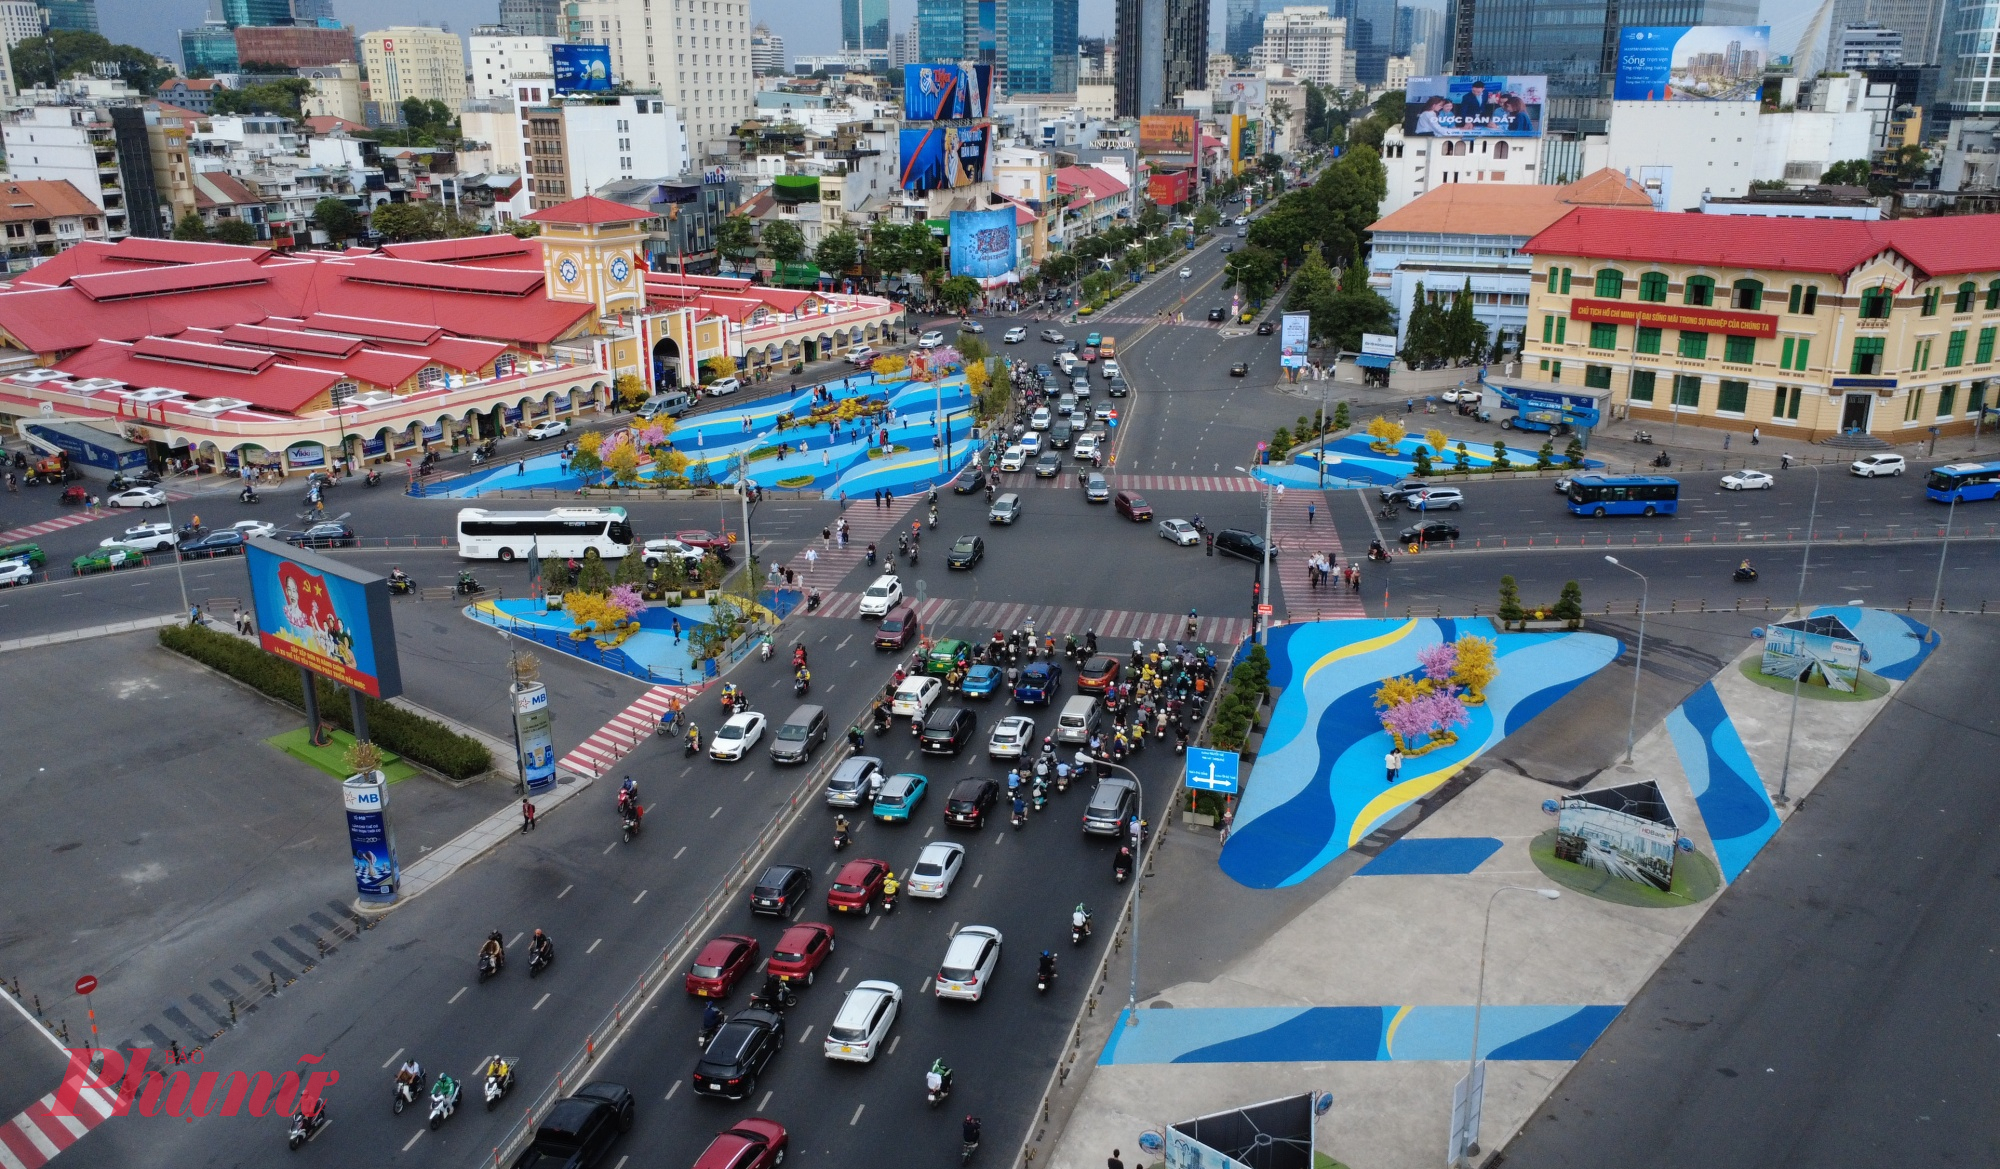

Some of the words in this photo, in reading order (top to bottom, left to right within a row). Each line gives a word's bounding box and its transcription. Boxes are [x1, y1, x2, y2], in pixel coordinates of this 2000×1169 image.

[1622, 54, 1646, 66] Sống
[1464, 114, 1490, 124] DẪN
[1578, 306, 1589, 315] CHỦ
[1590, 308, 1601, 316] TỊCH
[1602, 308, 1610, 316] HỒ
[1611, 309, 1620, 317] CHÍ
[1642, 313, 1651, 321] ĐẠI
[1652, 312, 1666, 322] SỐNG
[1667, 314, 1678, 322] MÃI
[1679, 316, 1697, 324] TRONG
[1698, 317, 1706, 326] SỰ
[1707, 318, 1727, 328] NGHIỆP
[1728, 319, 1740, 329] CỦA
[1741, 321, 1760, 330] CHÚNG
[1762, 323, 1769, 331] TA
[292, 448, 310, 458] Vikki
[532, 693, 546, 705] MB
[358, 794, 379, 804] MB
[1642, 827, 1666, 838] HDBank
